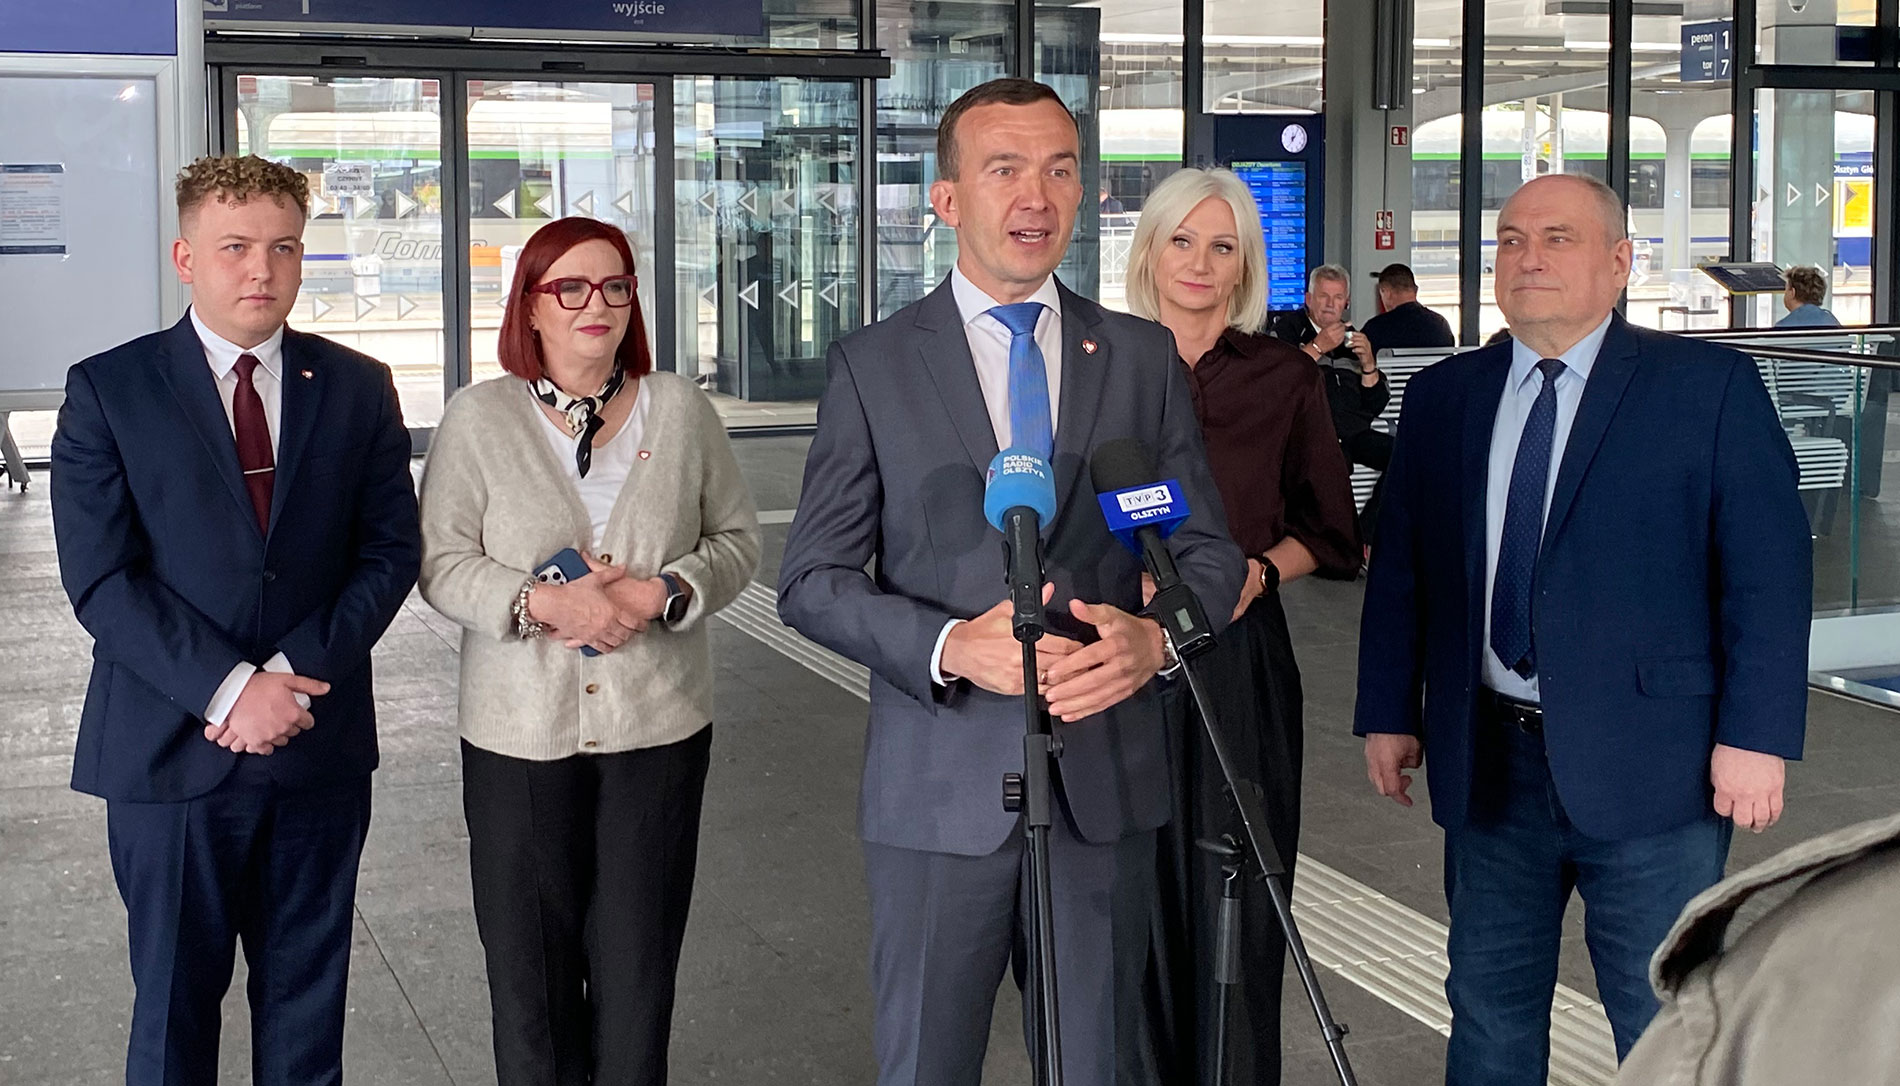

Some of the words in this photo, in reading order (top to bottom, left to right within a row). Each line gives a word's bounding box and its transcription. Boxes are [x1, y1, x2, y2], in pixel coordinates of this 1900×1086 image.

[612, 0, 666, 17] wyjście
[1691, 33, 1714, 46] peron
[1722, 30, 1730, 50] 1
[1702, 61, 1713, 70] tor
[1720, 58, 1730, 76] 7
[1003, 454, 1043, 466] POLSKIE
[1003, 461, 1033, 470] RADIO
[1126, 493, 1151, 506] TVP
[1154, 489, 1167, 502] 3
[1130, 505, 1172, 521] OLSZTYN
